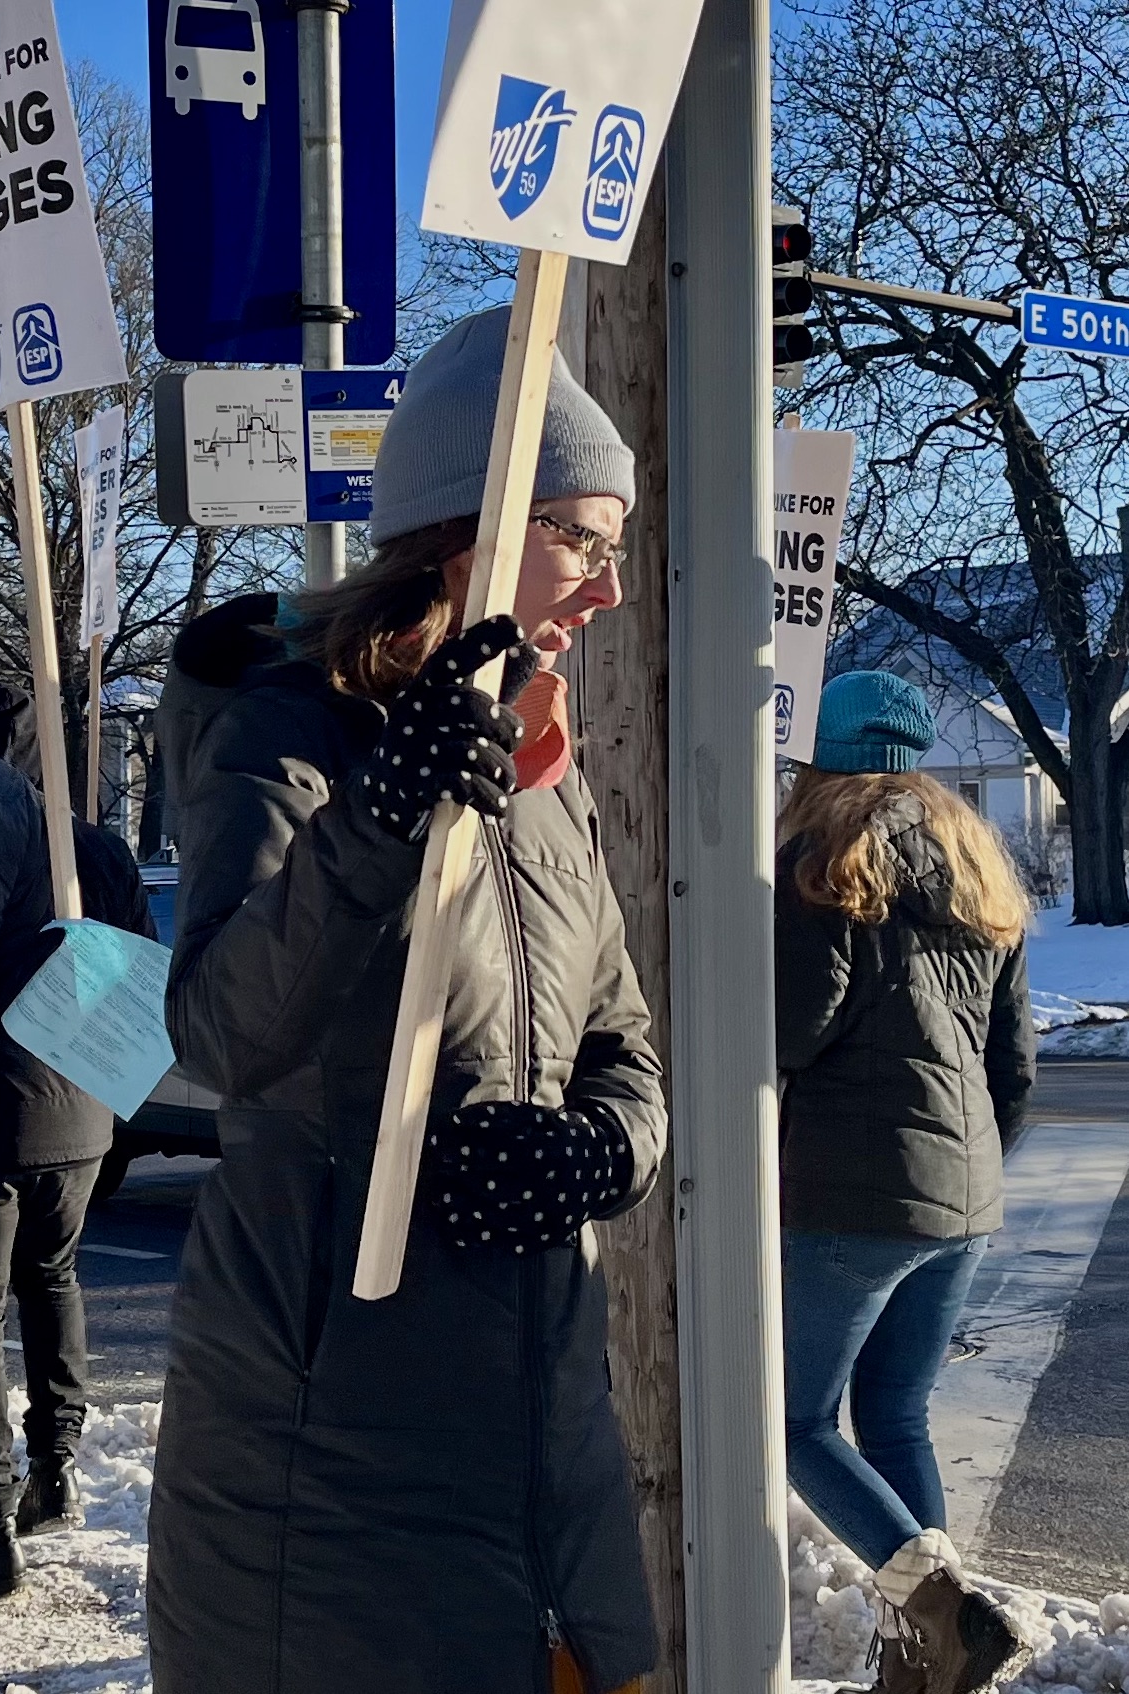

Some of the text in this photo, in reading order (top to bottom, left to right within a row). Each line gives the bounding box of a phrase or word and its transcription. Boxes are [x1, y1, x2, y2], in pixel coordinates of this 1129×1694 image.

[4, 37, 50, 76] FOR
[519, 171, 537, 197] 59
[597, 179, 625, 208] ESP
[1031, 303, 1129, 347] E 50th
[25, 346, 48, 366] ESP
[799, 494, 835, 516] FOR
